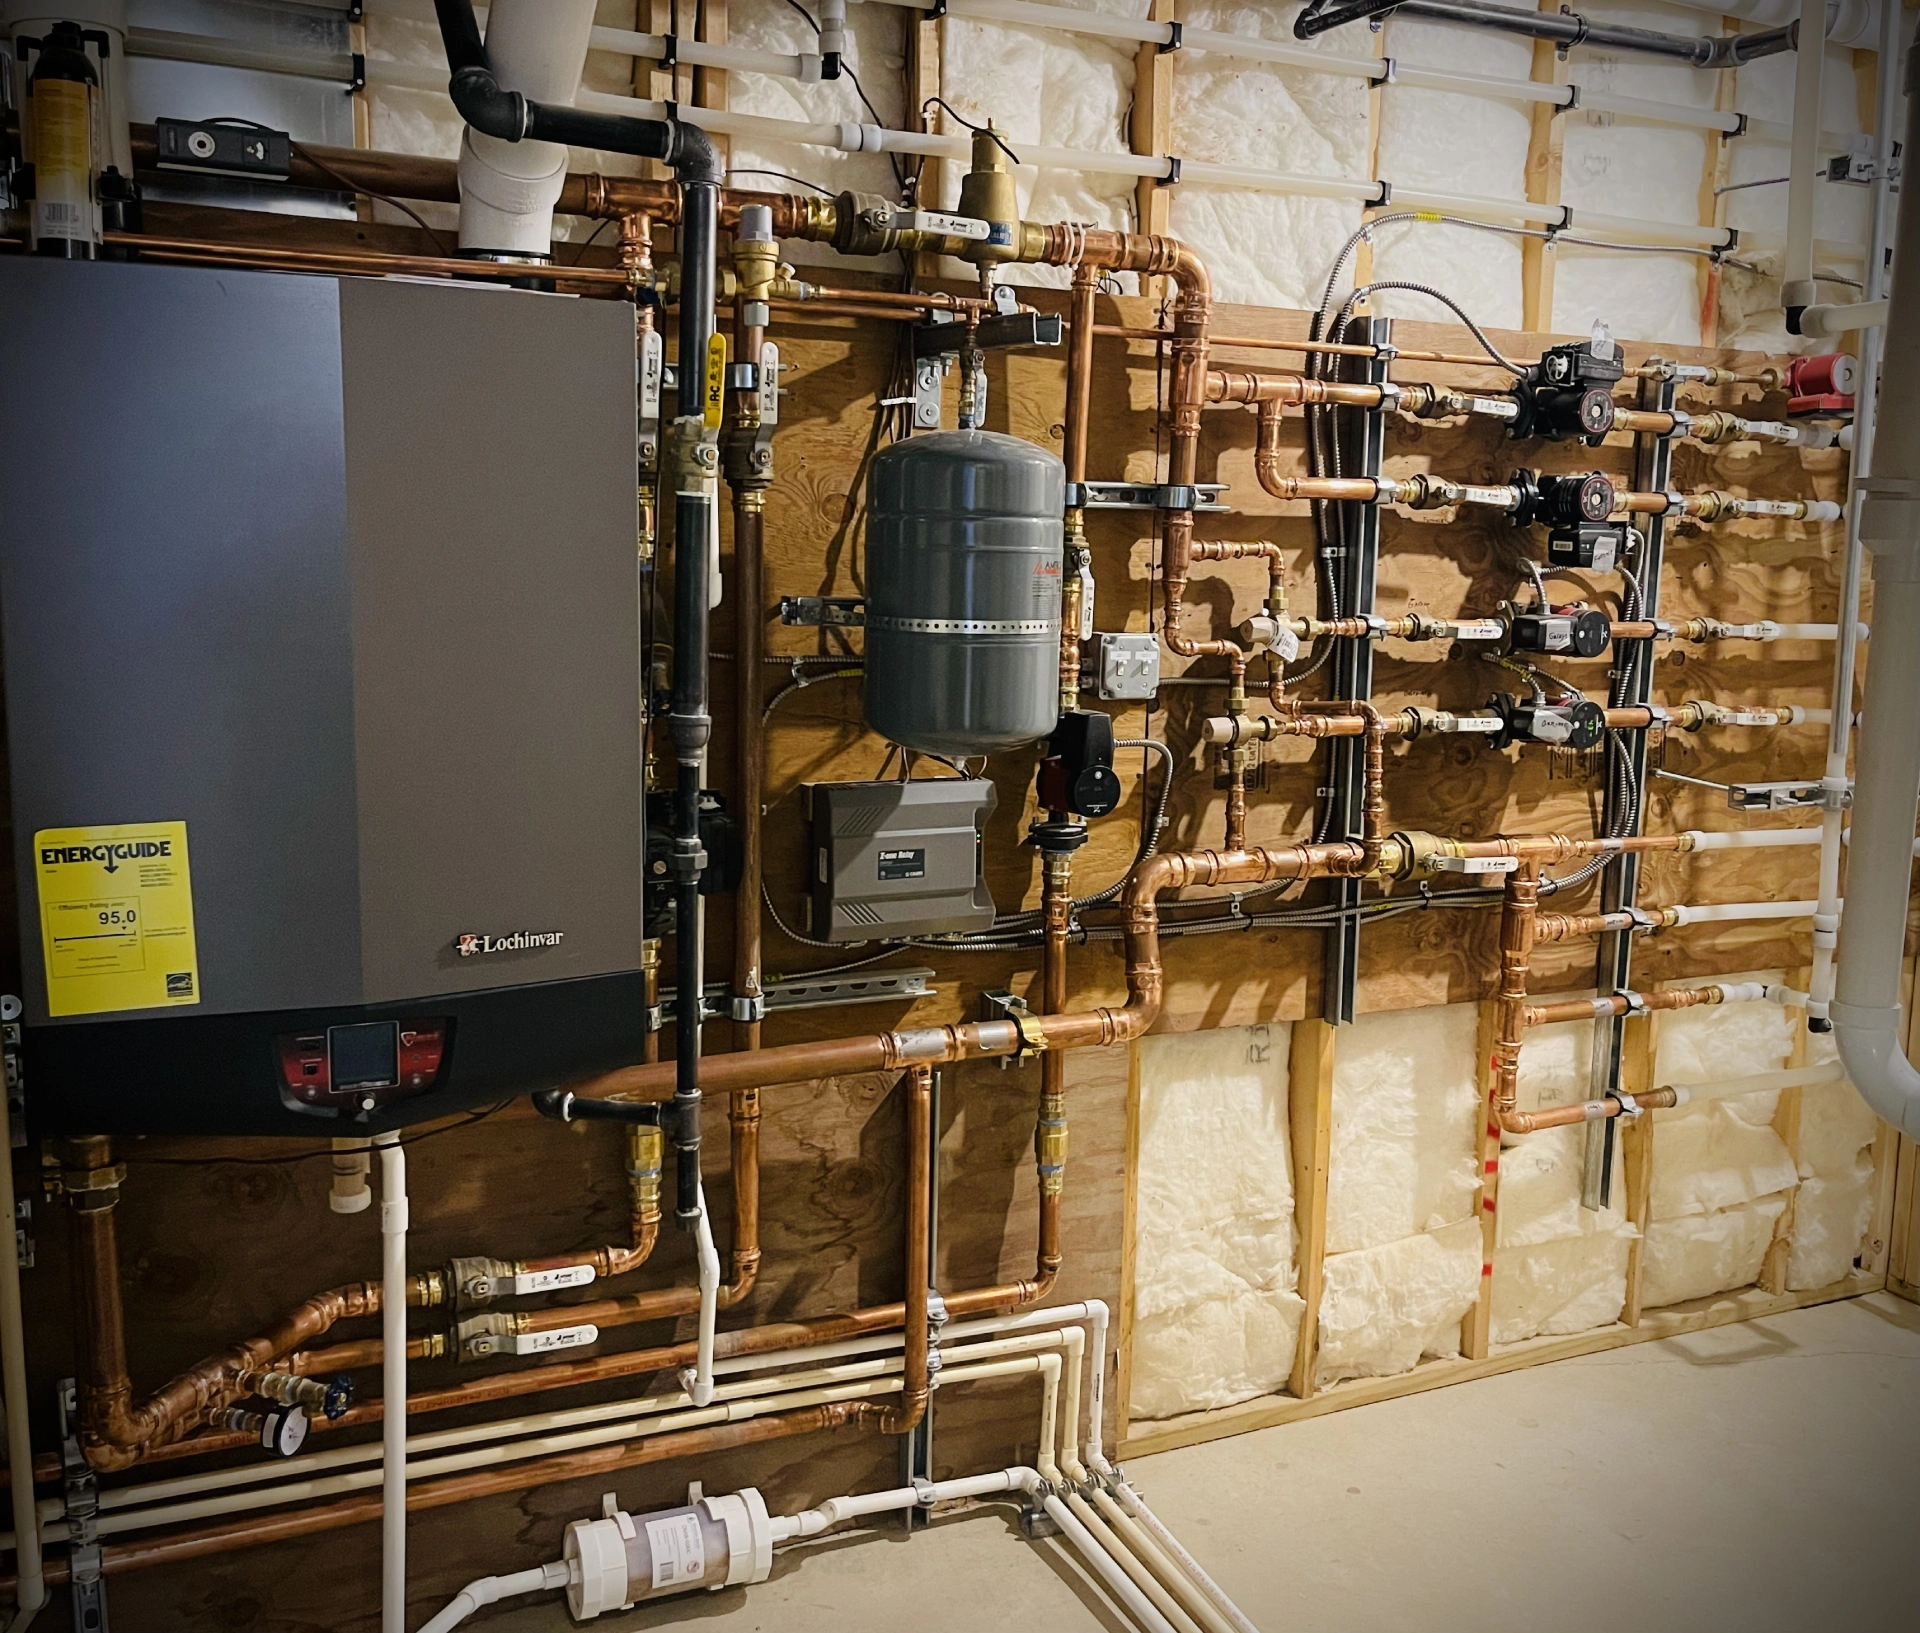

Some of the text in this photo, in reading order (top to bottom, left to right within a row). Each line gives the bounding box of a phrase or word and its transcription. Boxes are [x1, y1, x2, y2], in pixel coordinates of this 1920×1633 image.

[41, 841, 171, 867] ENERGYGUIDE
[58, 901, 109, 911] Efficiency Rating
[99, 910, 136, 925] 95.0
[483, 931, 564, 953] Lochinvar
